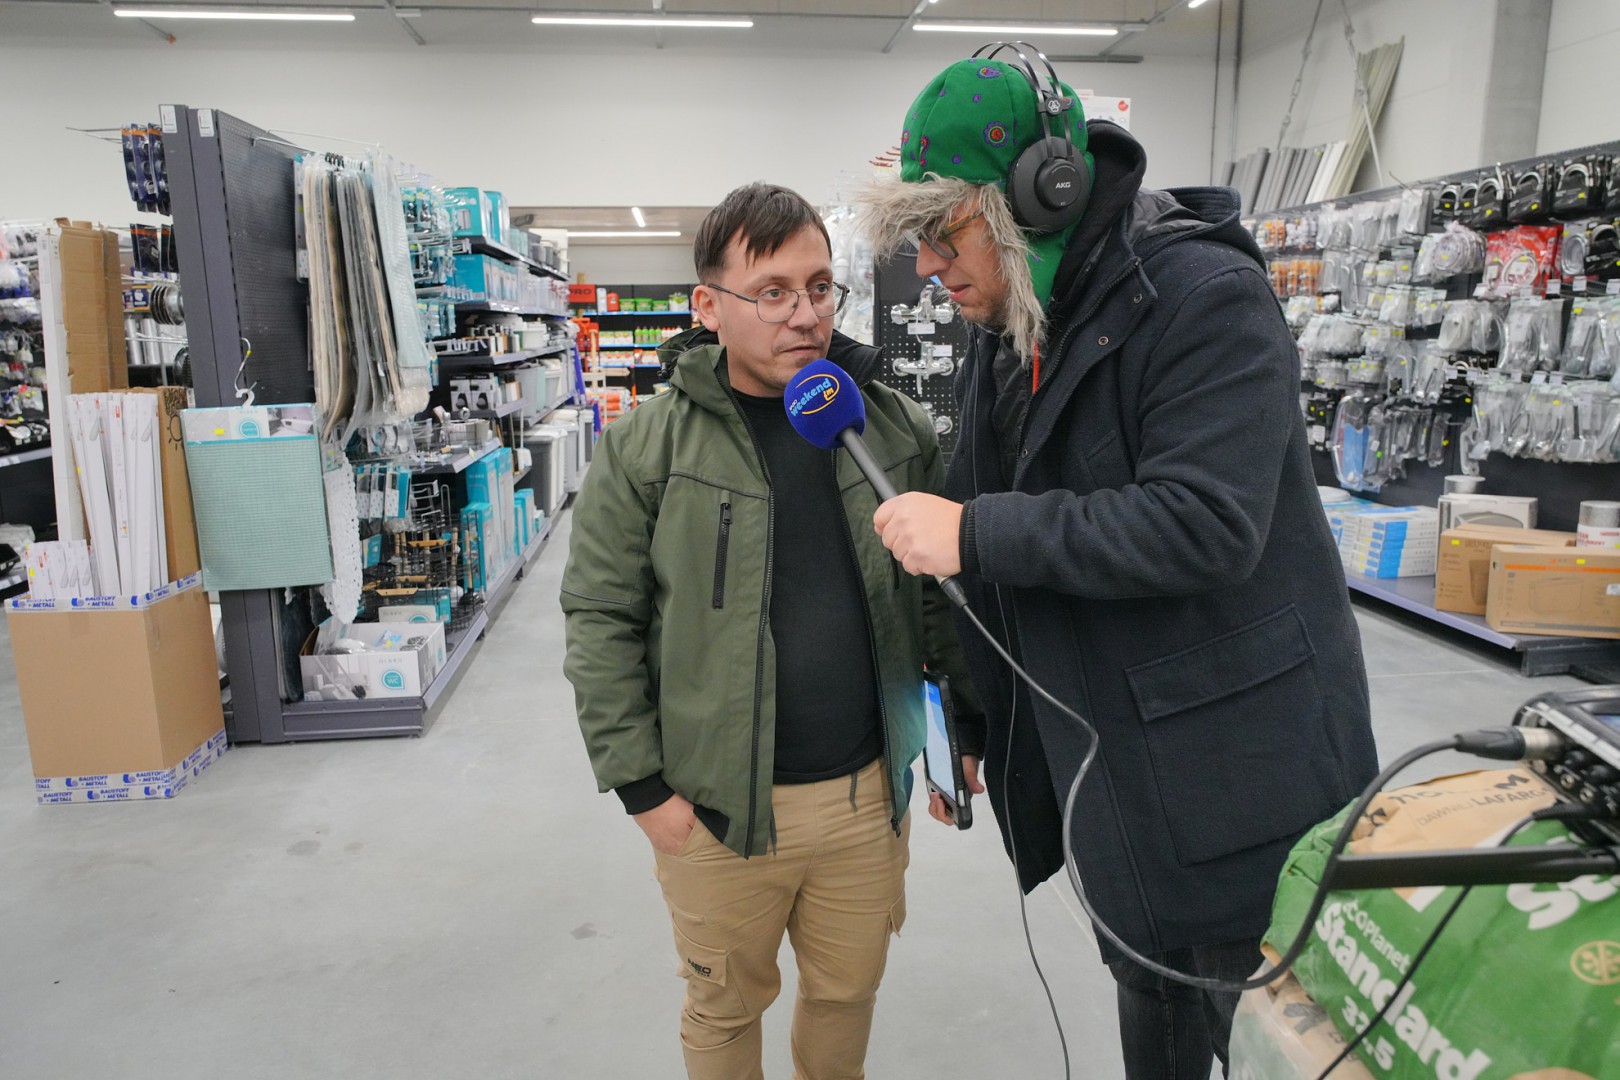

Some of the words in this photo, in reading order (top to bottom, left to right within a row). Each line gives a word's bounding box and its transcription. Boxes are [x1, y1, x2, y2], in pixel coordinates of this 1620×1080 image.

[1055, 181, 1071, 189] AKG
[790, 377, 831, 416] weekend
[1315, 902, 1492, 1080] Standard
